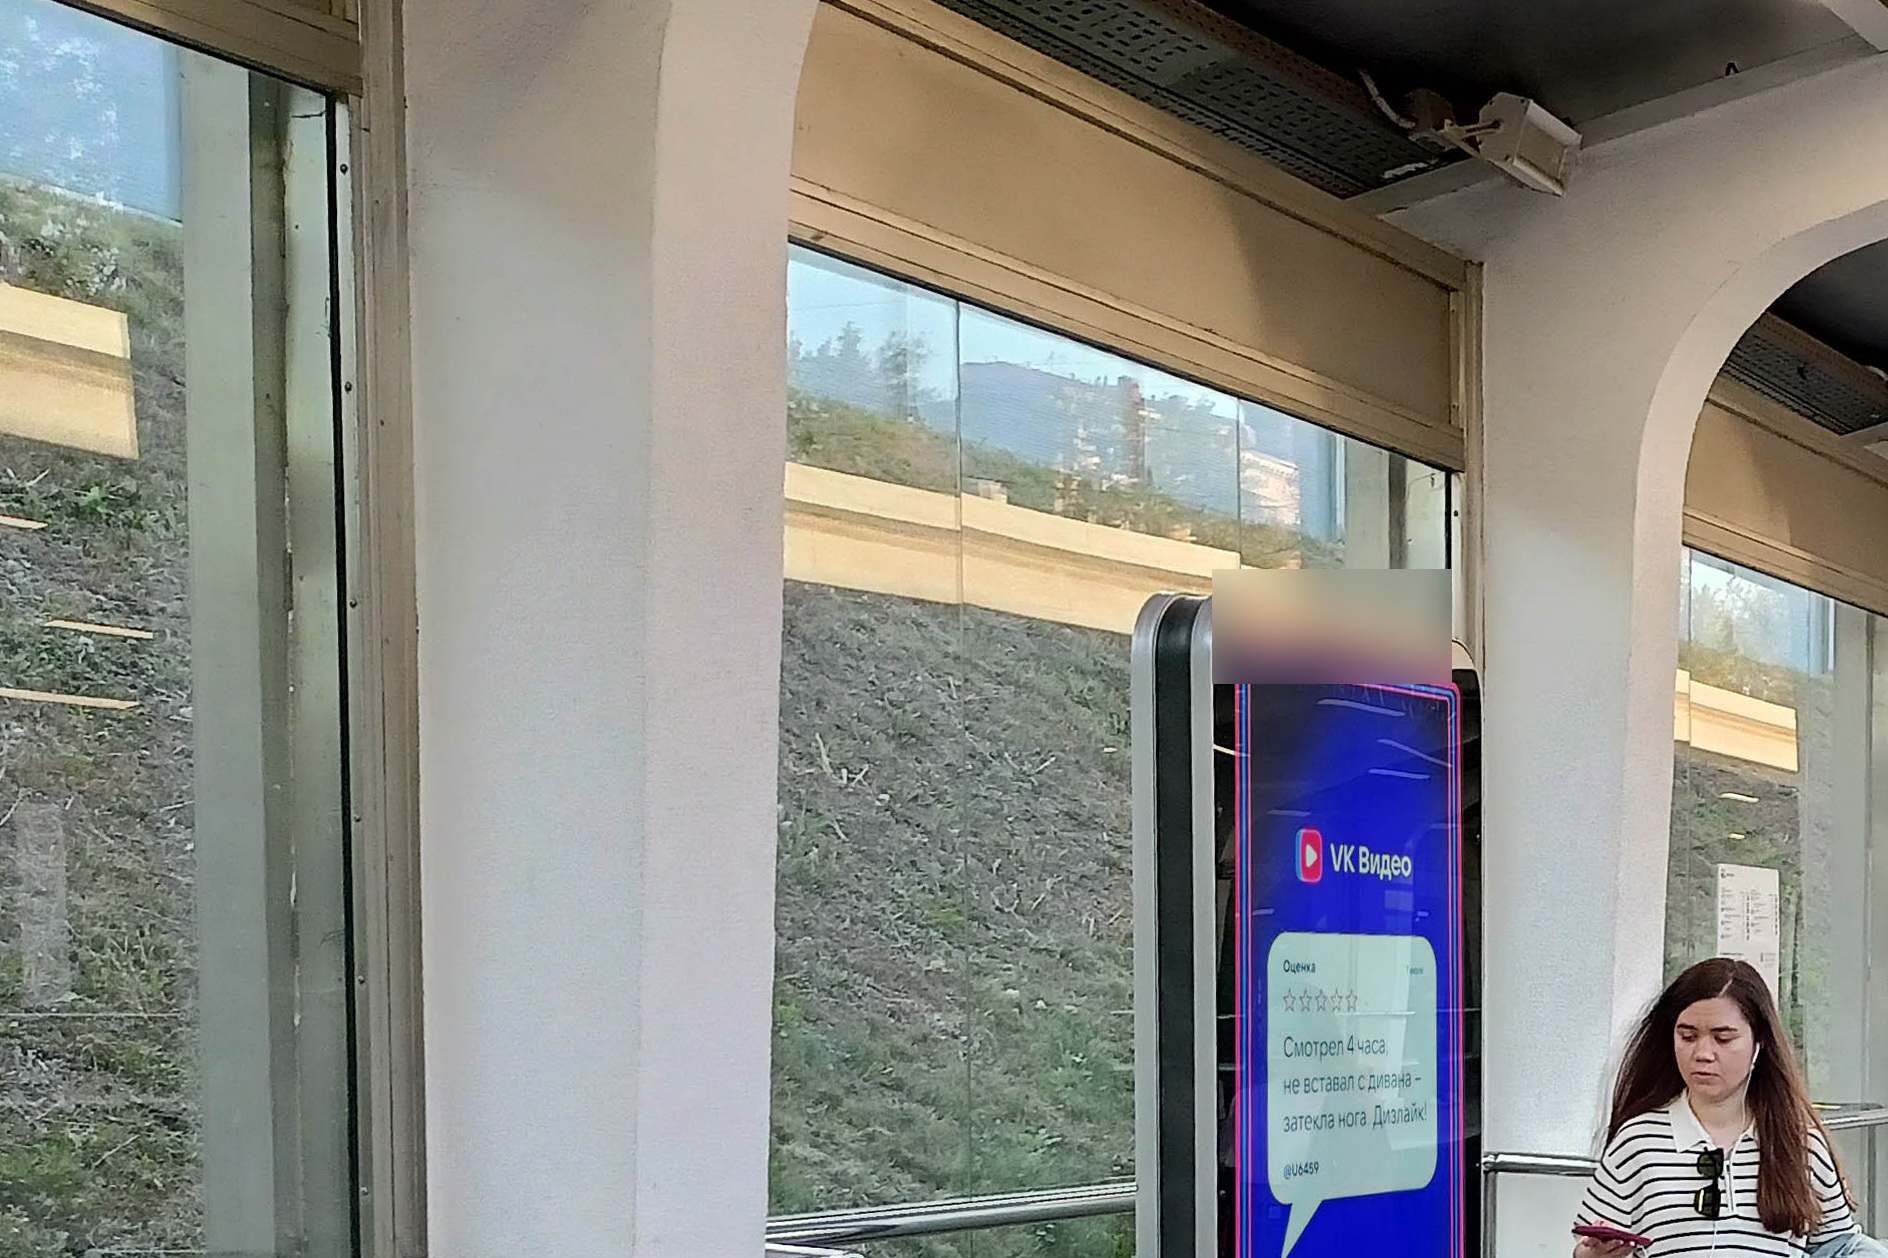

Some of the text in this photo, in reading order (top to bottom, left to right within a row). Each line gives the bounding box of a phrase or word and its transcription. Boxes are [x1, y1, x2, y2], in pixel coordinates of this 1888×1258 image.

[1330, 843, 1412, 880] VK Видео
[1282, 959, 1316, 974] Оценка
[1283, 1035, 1389, 1061] Смотрел 4 часа,
[1283, 1078, 1301, 1094] не
[1303, 1075, 1355, 1094] вставал
[1357, 1075, 1365, 1090] с
[1367, 1072, 1412, 1092] дивана
[1283, 1113, 1335, 1132] затекла
[1372, 1101, 1427, 1129] Дизлайк!
[1283, 1161, 1319, 1179] @U6459
